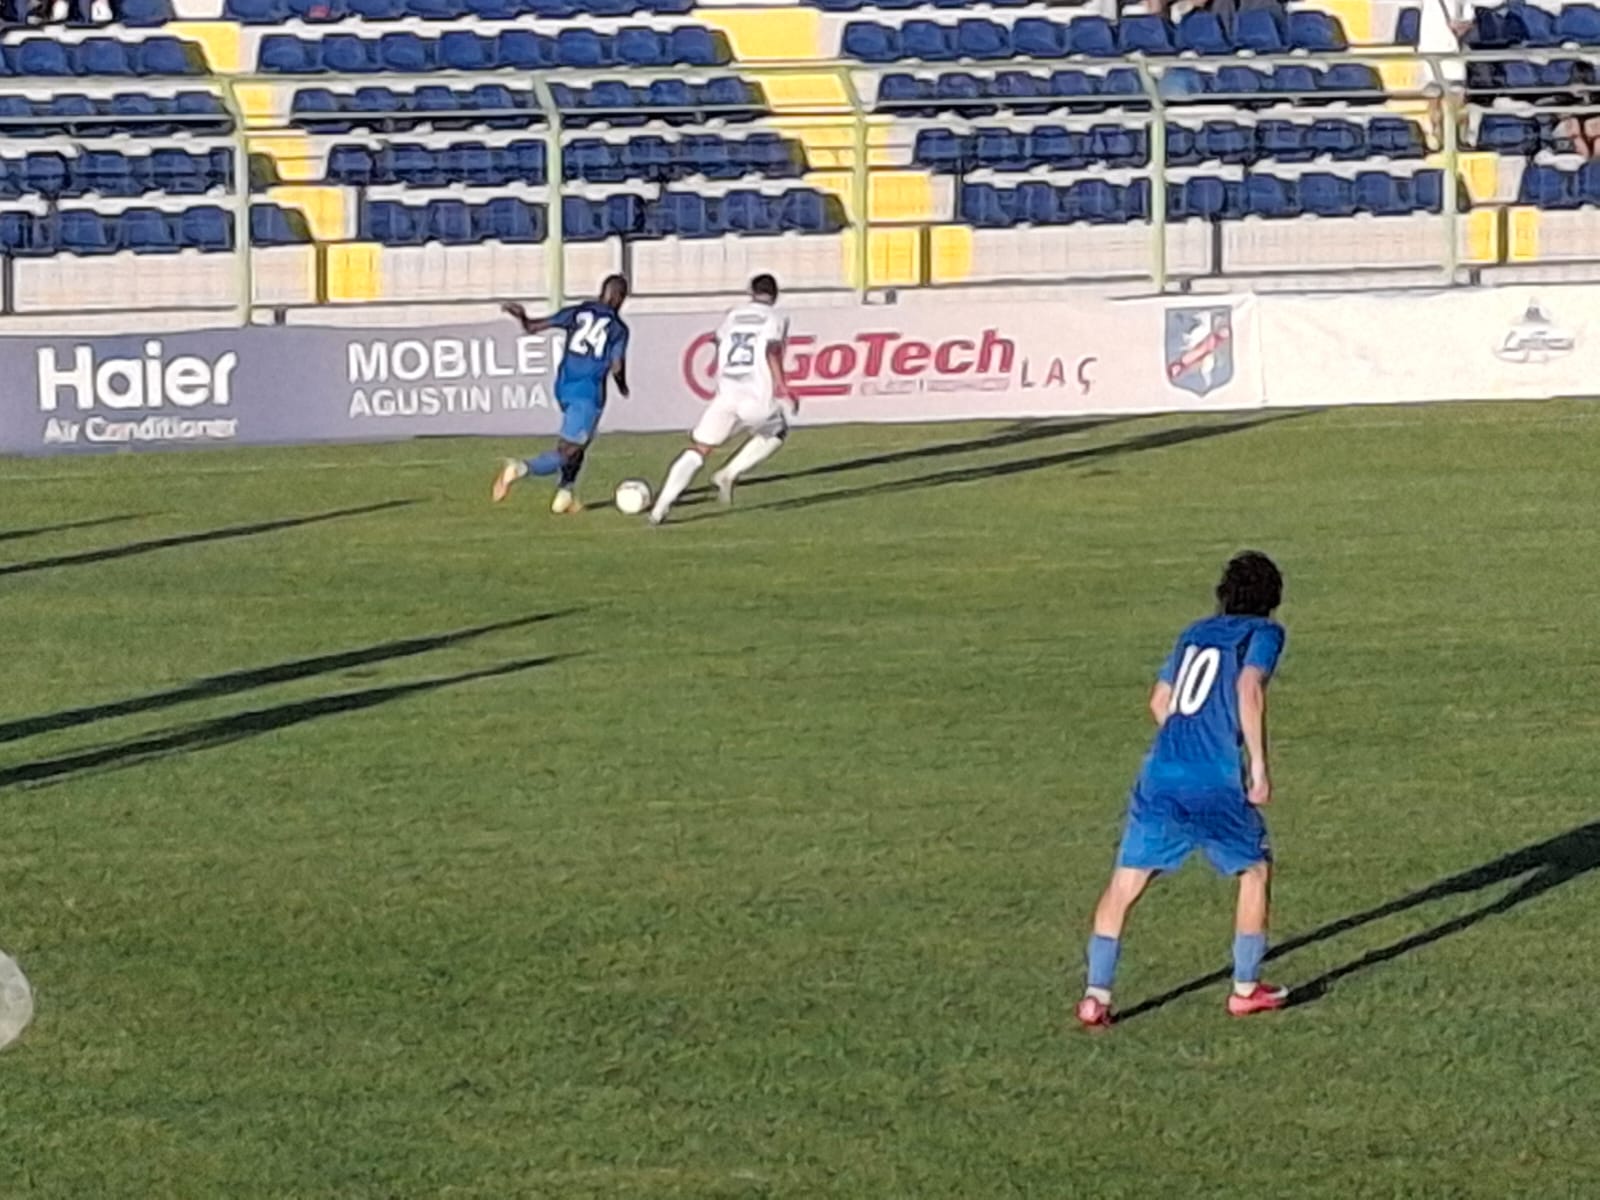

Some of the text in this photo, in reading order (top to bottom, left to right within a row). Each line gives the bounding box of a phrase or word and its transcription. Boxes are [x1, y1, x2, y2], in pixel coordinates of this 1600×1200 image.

[569, 311, 611, 358] 24
[37, 340, 238, 411] Haier
[350, 385, 492, 418] AGUSTIN
[44, 415, 239, 444] Air Conditioner
[1169, 644, 1221, 714] 10
